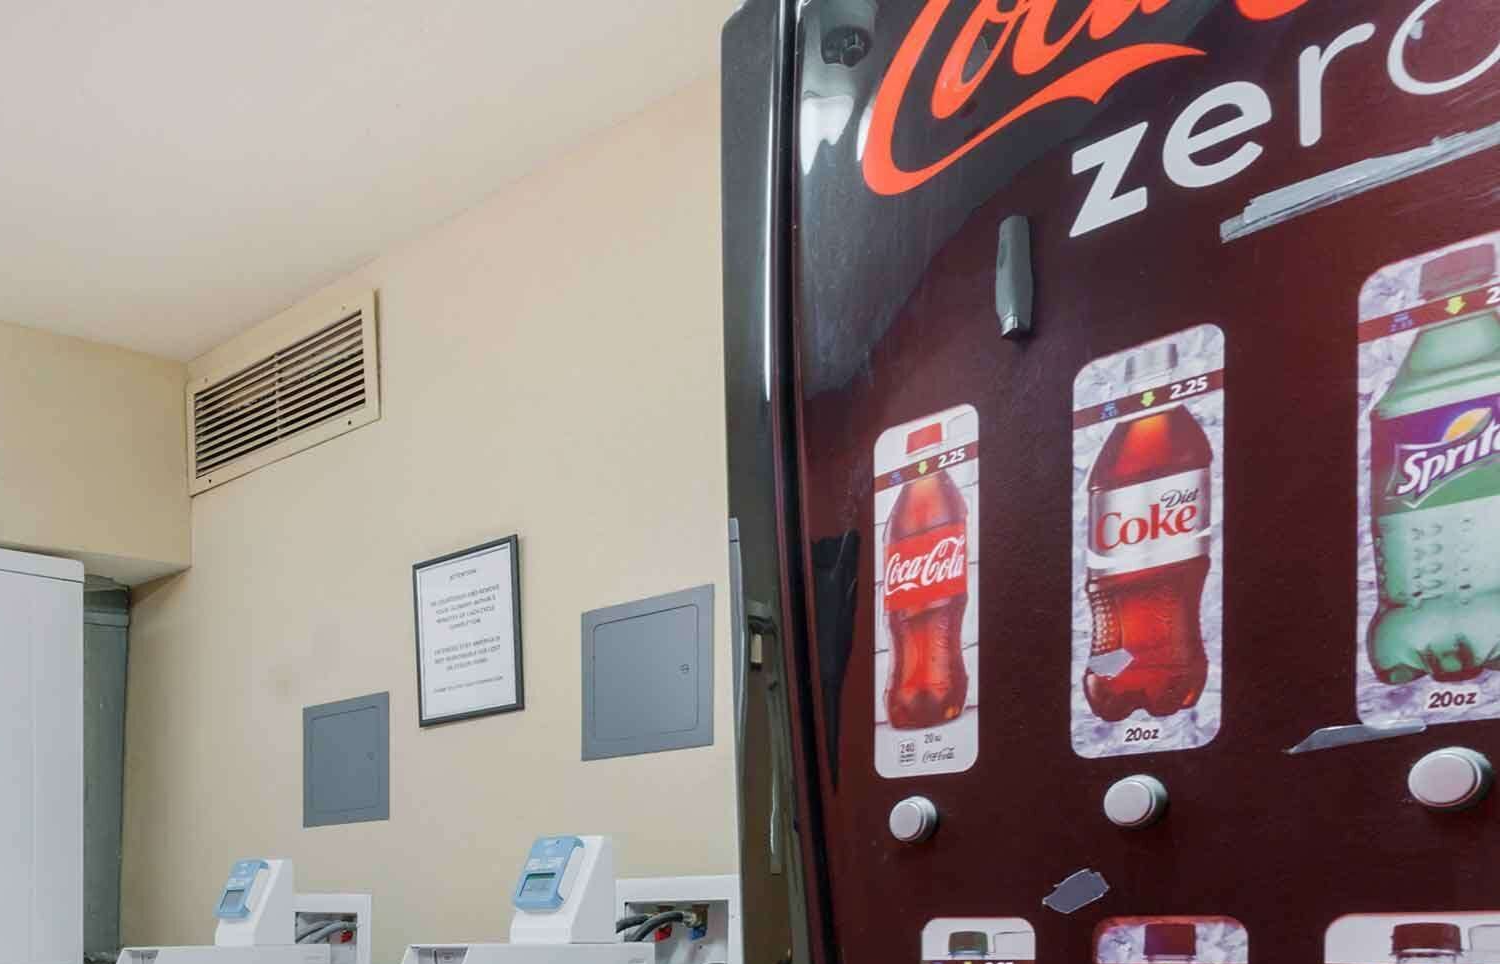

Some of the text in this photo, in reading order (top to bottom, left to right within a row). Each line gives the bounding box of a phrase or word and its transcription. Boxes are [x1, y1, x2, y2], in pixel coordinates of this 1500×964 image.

[1068, 0, 1500, 239] zero
[1169, 376, 1208, 400] 2.25
[937, 448, 966, 469] 2.25
[1160, 488, 1199, 509] Diet
[1094, 503, 1197, 550] Coke
[885, 534, 965, 596] Coca-Cola
[1428, 690, 1477, 709] 20oz
[1124, 727, 1159, 742] 20oz
